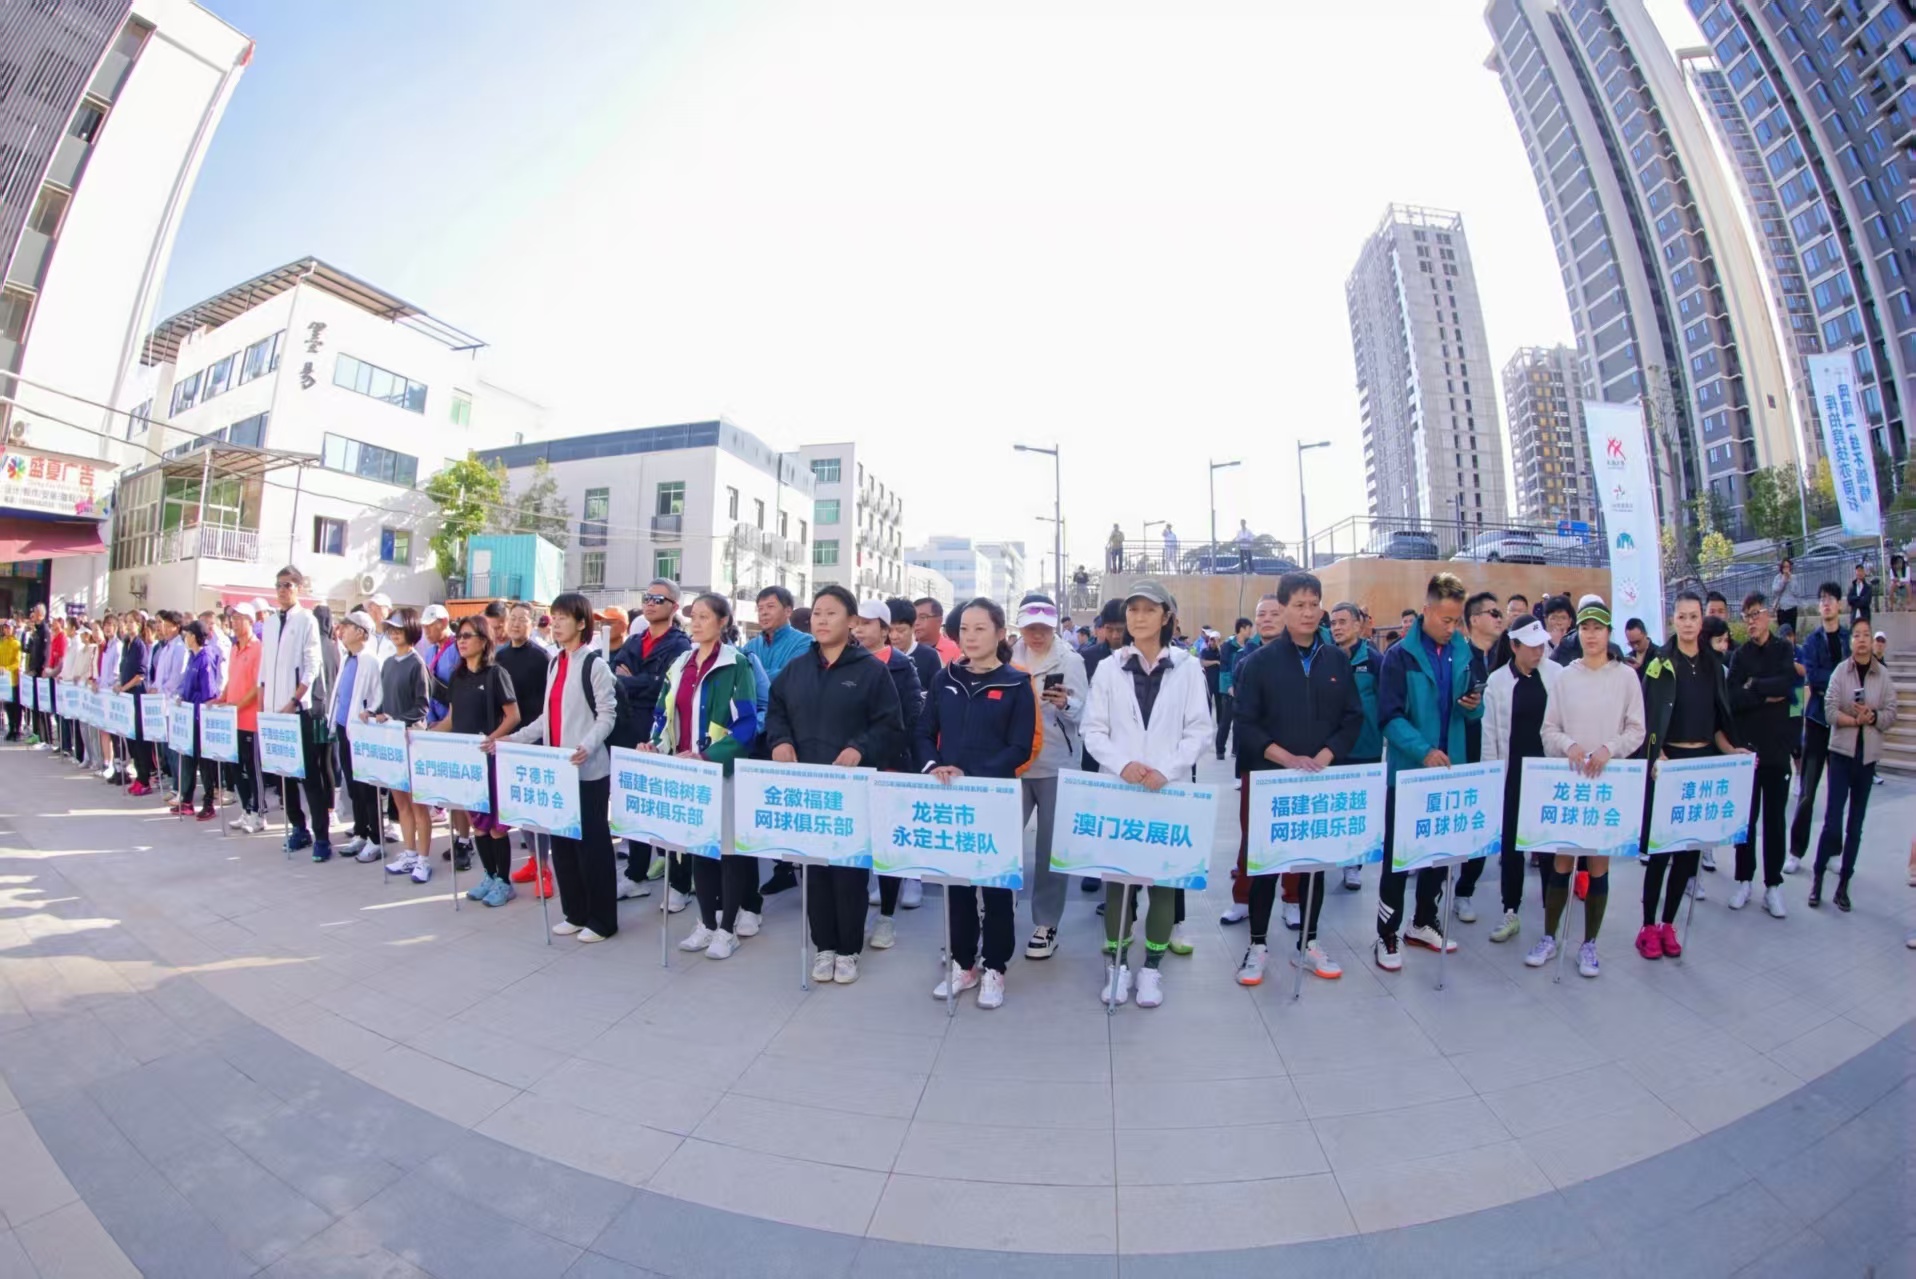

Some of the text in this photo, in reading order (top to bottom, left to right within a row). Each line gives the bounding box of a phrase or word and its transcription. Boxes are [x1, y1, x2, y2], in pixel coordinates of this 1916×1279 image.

[29, 456, 94, 486] 盛夏广告
[515, 765, 556, 786] 宁德市
[618, 770, 713, 806] 福建省榕树春
[510, 784, 565, 809] 网球协会
[763, 785, 844, 811] 金徽福建
[1425, 787, 1479, 813] 厦门市
[1552, 782, 1613, 803] 龙岩市
[1681, 778, 1729, 801] 漳州市
[625, 794, 704, 827] 网球俱乐部
[911, 801, 976, 827] 龙岩市
[1271, 790, 1368, 818] 福建省凌越
[1540, 804, 1621, 828] 网球协会
[1670, 800, 1736, 825] 网球协会
[754, 809, 855, 837] 网球俱乐部
[1072, 812, 1193, 849] 澳门发展队
[1270, 816, 1367, 844] 网球俱乐部
[1415, 810, 1486, 840] 网球协会
[892, 826, 999, 855] 永定土楼队
